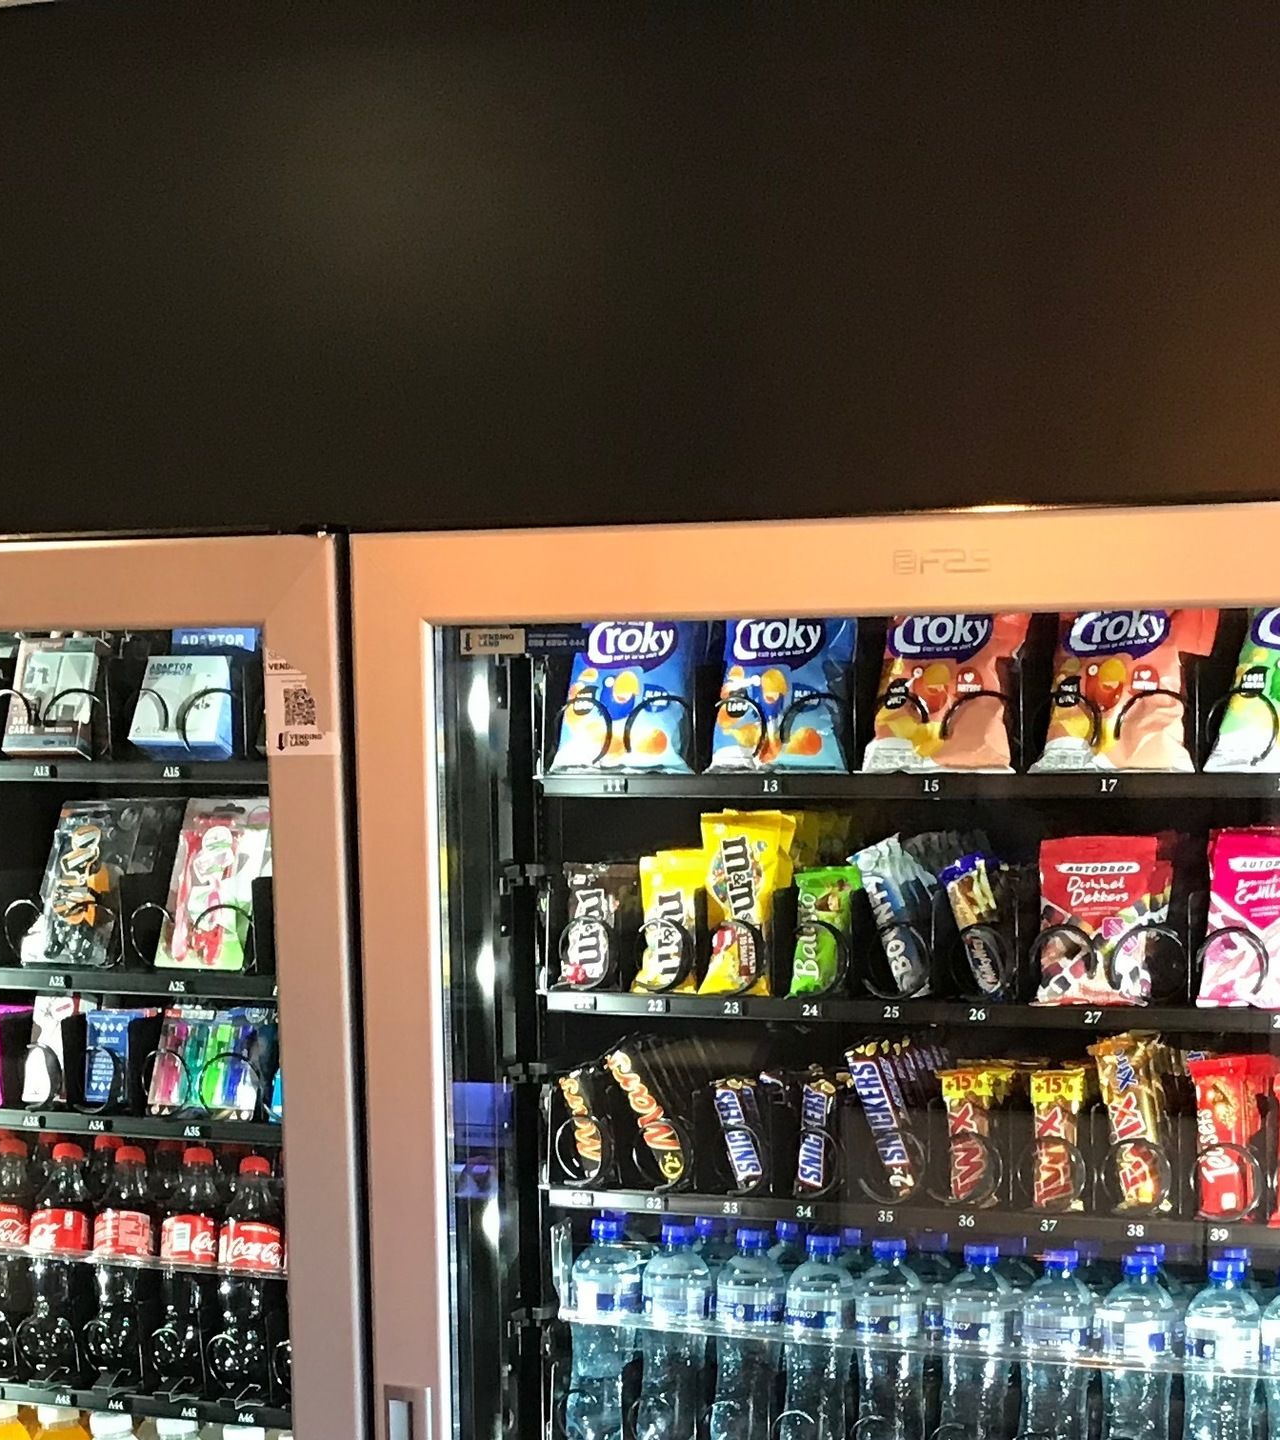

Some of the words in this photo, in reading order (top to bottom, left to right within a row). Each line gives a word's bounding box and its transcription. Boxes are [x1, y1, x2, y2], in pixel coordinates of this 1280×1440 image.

[894, 614, 989, 654] Croky
[1069, 610, 1166, 651] Croky
[587, 621, 674, 664] Croky
[733, 618, 821, 661] Croky
[149, 661, 193, 673] ADAPTOR
[34, 766, 50, 777] A13
[163, 766, 180, 778] A15
[762, 779, 779, 793] 13
[923, 779, 940, 793] 15
[1100, 779, 1118, 794] 17
[1066, 864, 1134, 873] AUTODROP
[1070, 888, 1129, 907] Dekkers
[49, 975, 65, 987] A23
[169, 981, 185, 992] A25
[647, 999, 664, 1012] 22
[723, 1001, 740, 1014] 23
[802, 1004, 819, 1017] 24
[883, 1005, 900, 1018] 25
[968, 1008, 986, 1021] 26
[1083, 1010, 1102, 1024] 27
[1034, 1076, 1074, 1094] +15%
[849, 1062, 910, 1165] SNICKERS
[23, 1115, 39, 1126] A33
[88, 1119, 105, 1131] A34
[183, 1125, 201, 1137] A35
[646, 1198, 663, 1210] 32
[723, 1201, 739, 1215] 33
[796, 1205, 812, 1218] 34
[878, 1210, 894, 1223] 35
[958, 1214, 975, 1227] 36
[1040, 1218, 1058, 1232] 37
[1126, 1223, 1145, 1237] 38
[1209, 1228, 1229, 1242] 39
[55, 1394, 71, 1405] A43
[108, 1399, 125, 1410] A44
[181, 1406, 198, 1418] A45
[238, 1412, 255, 1424] A46
